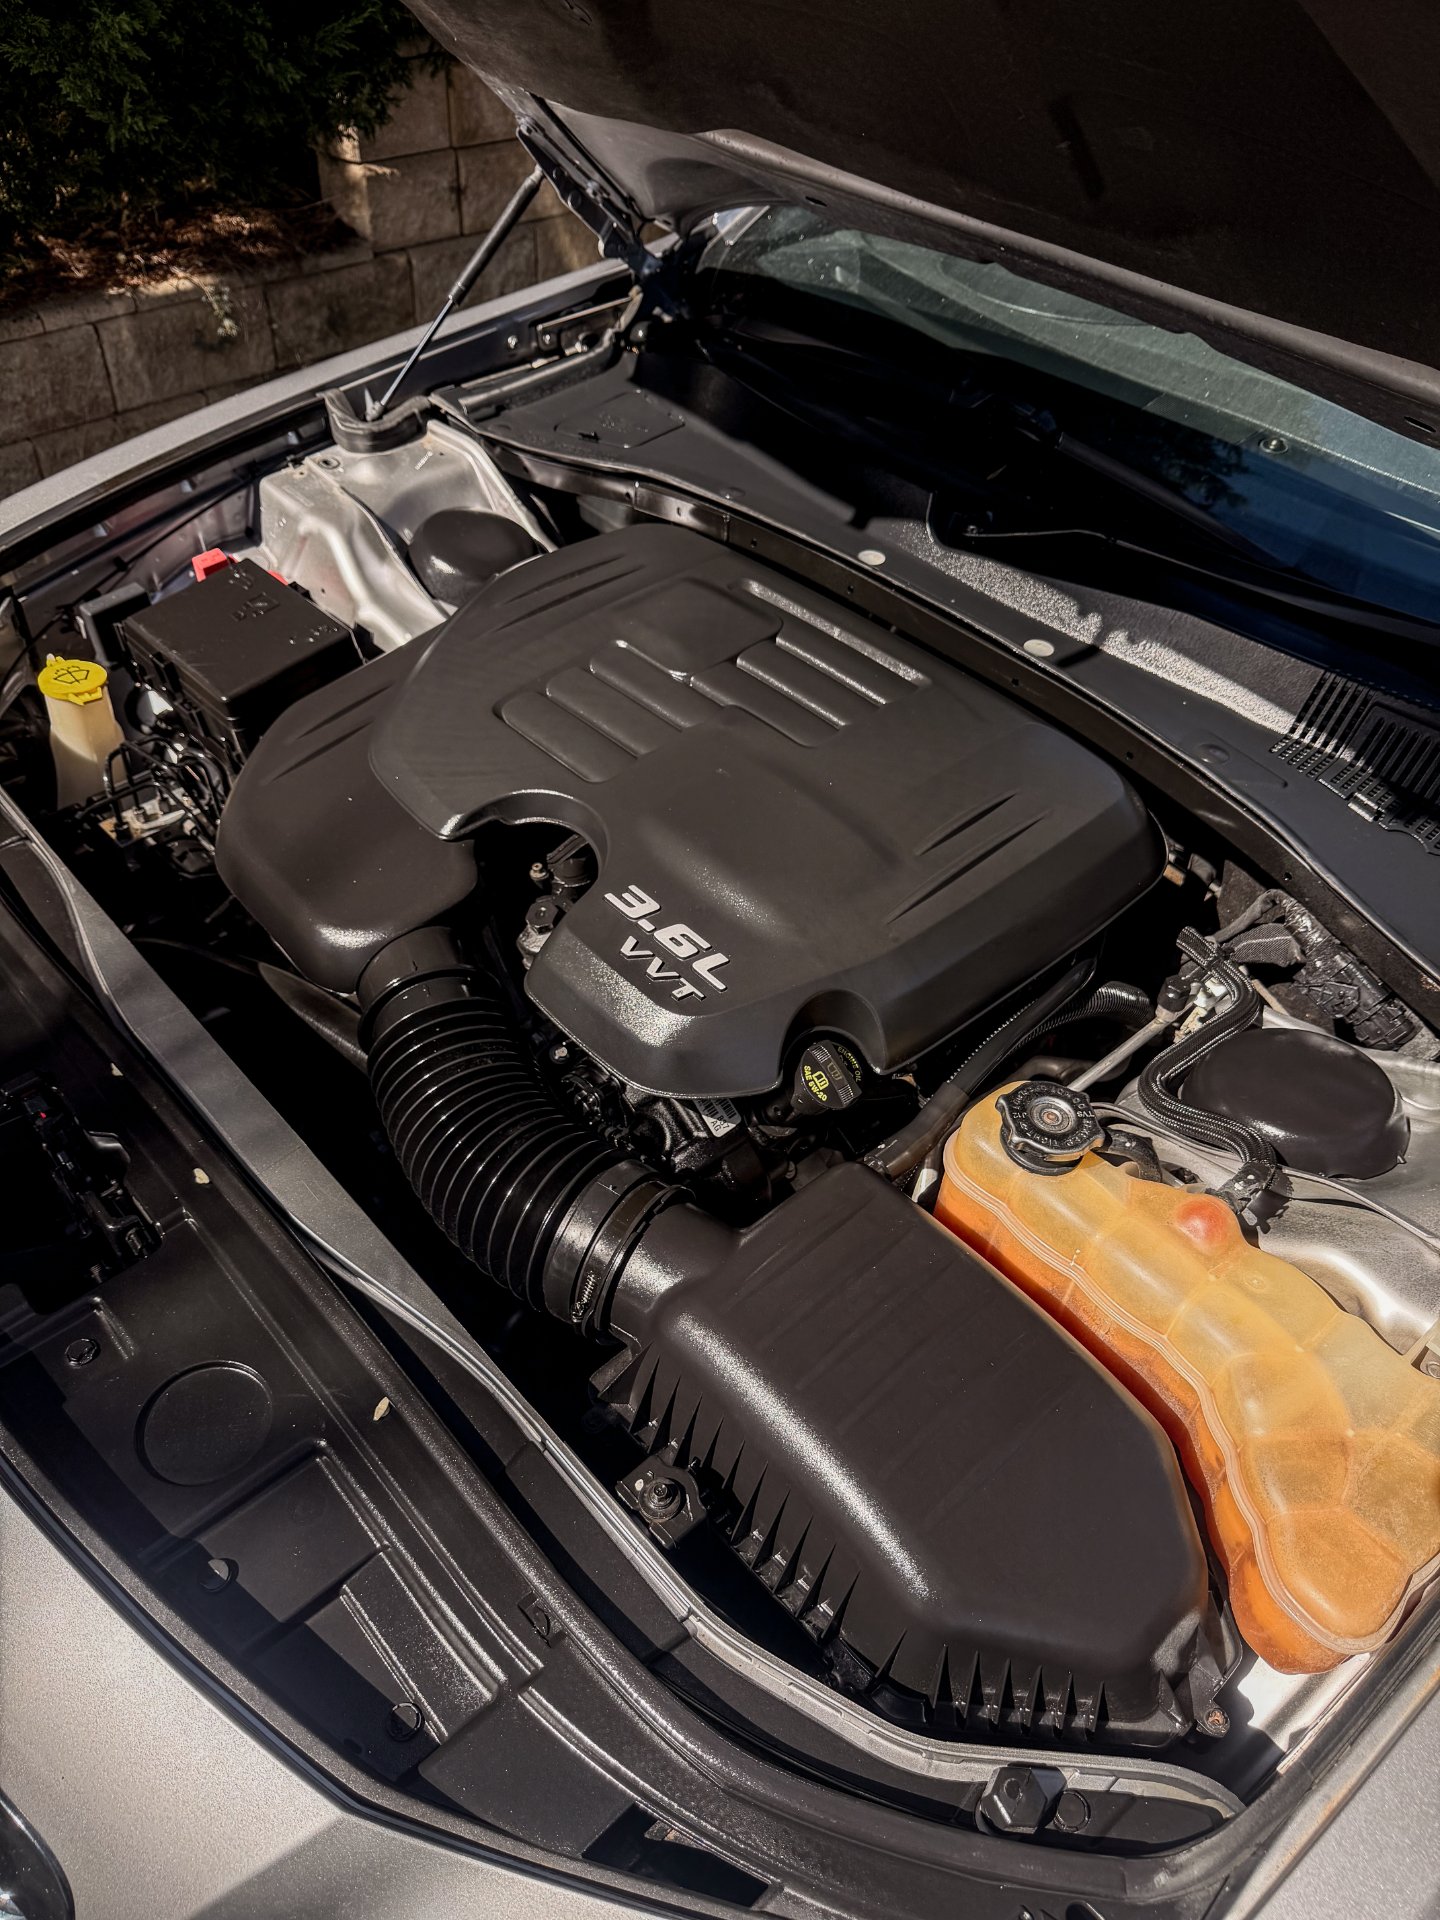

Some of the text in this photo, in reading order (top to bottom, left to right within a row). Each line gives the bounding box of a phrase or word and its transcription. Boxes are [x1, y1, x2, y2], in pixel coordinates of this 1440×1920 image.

[603, 884, 731, 992] 3.6L
[619, 935, 706, 1001] VVT
[803, 1065, 828, 1101] SAE 5W-20
[837, 1046, 862, 1082] ENGINE OIL
